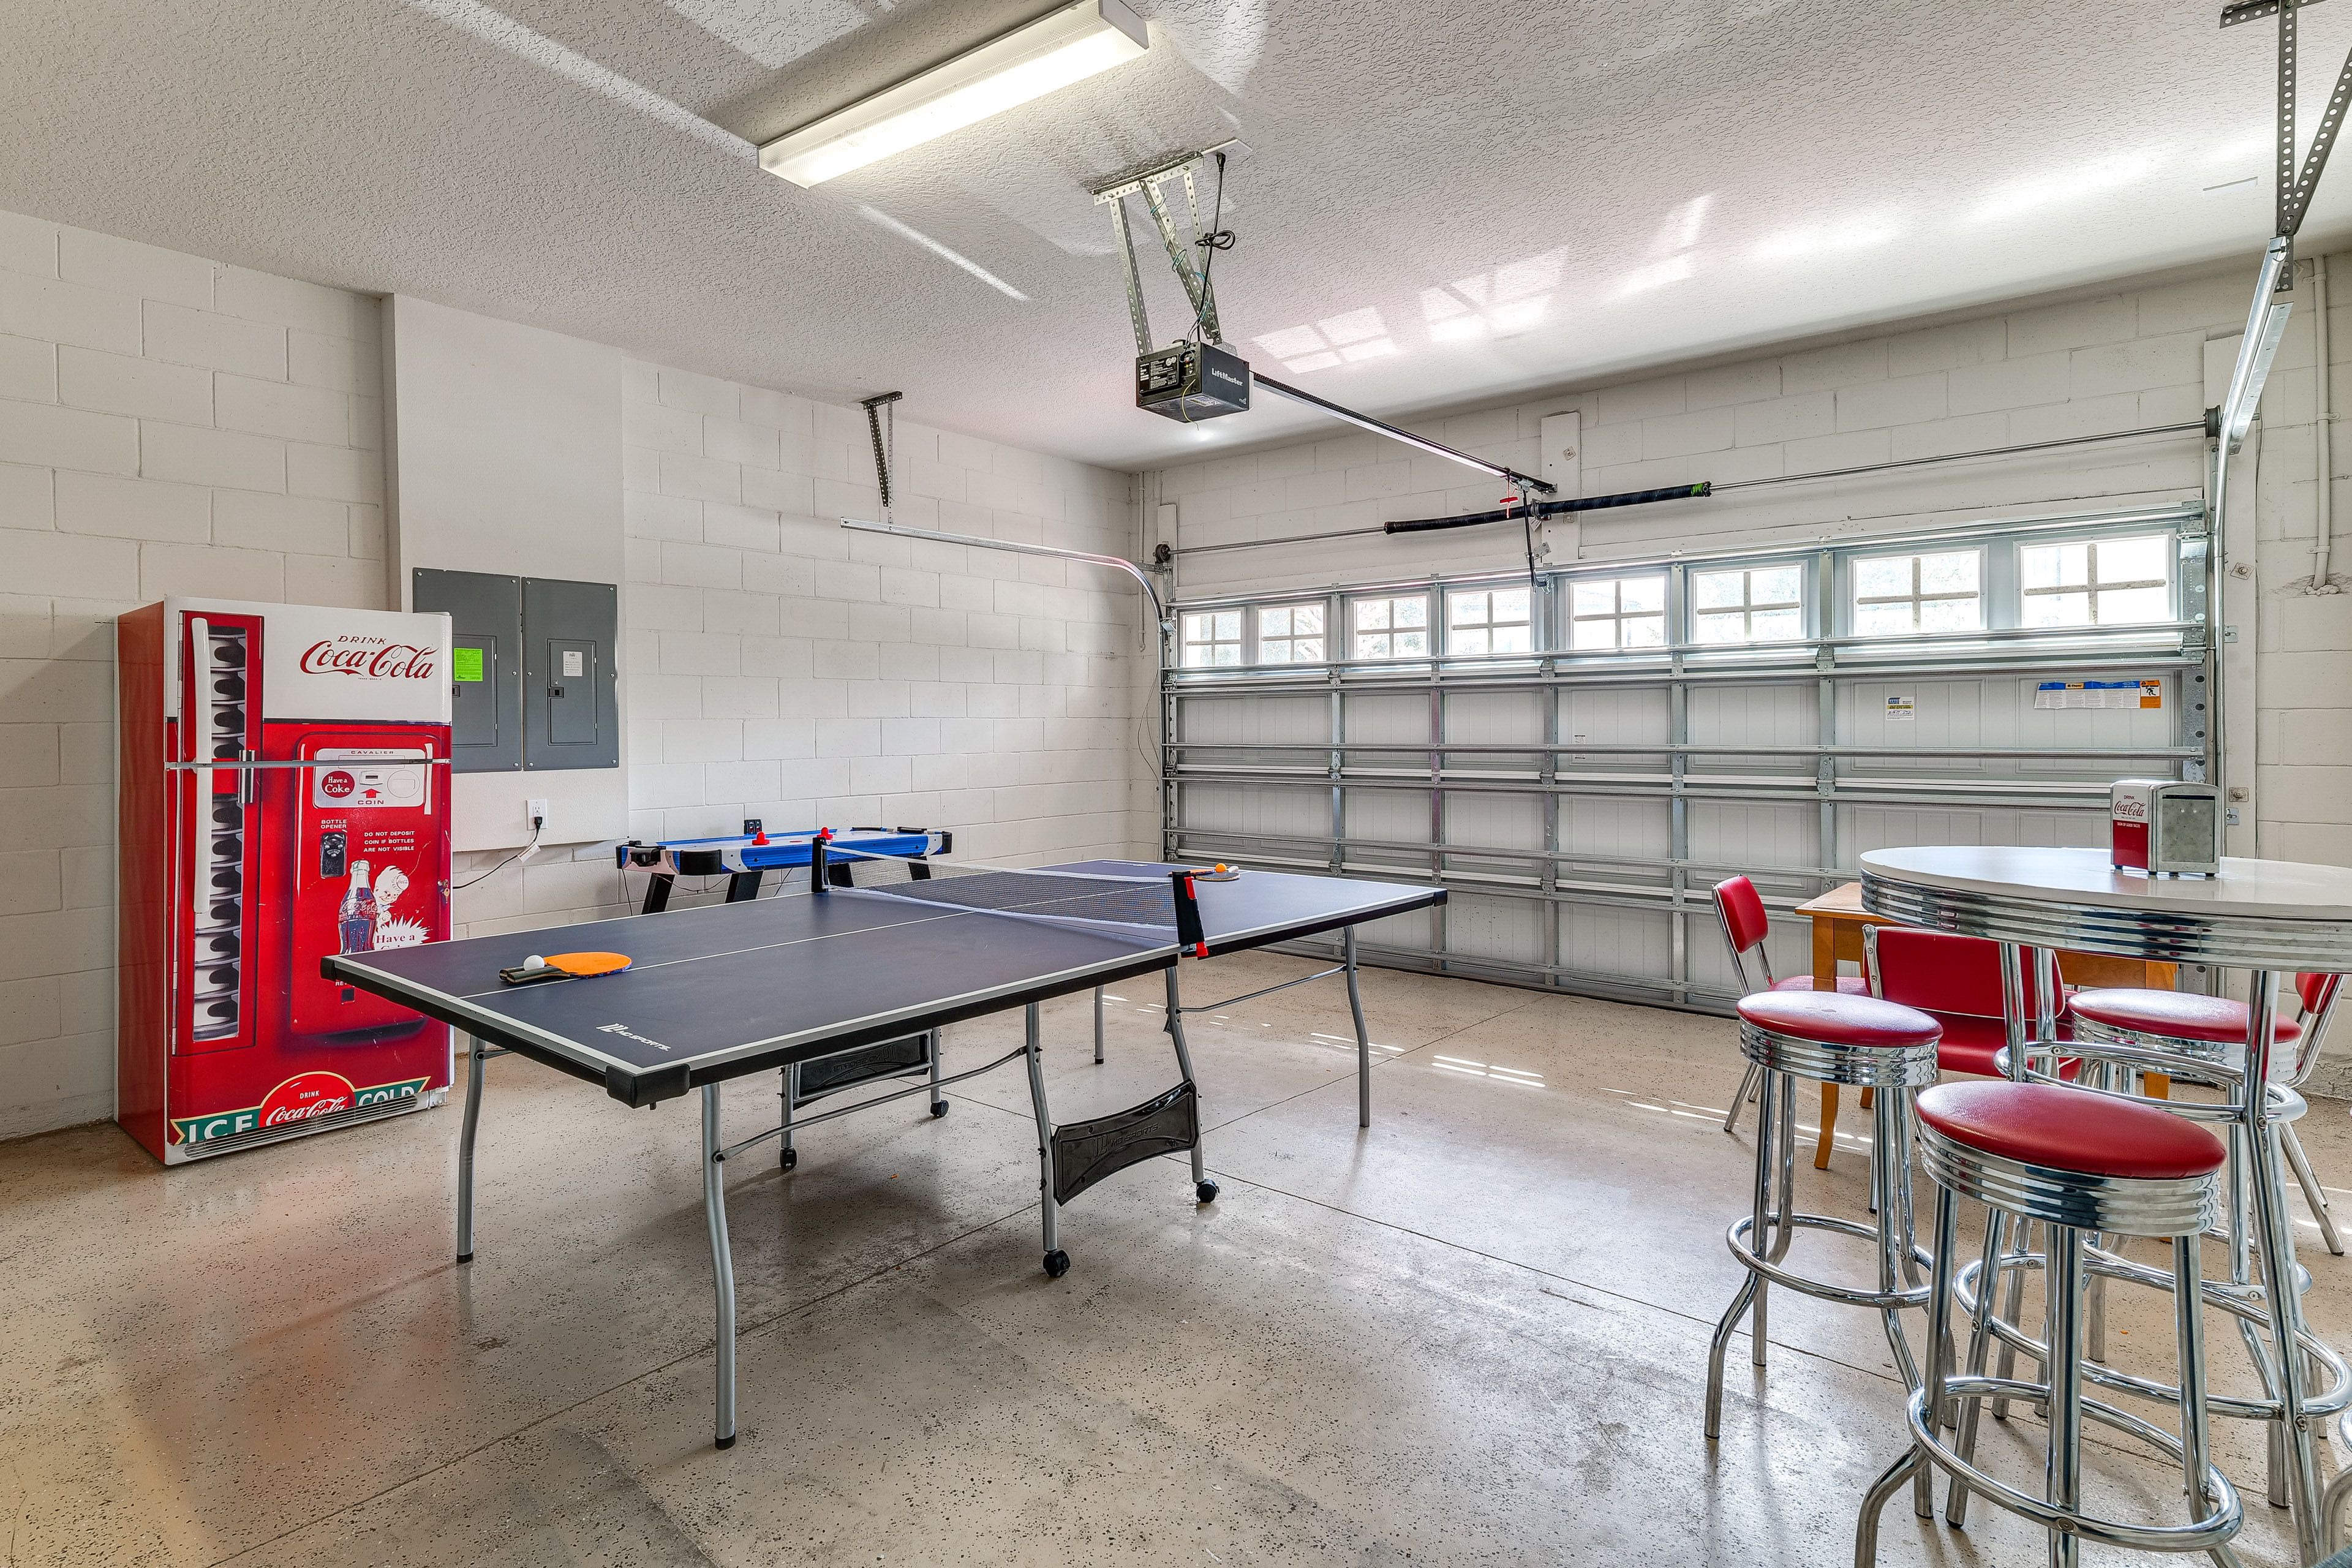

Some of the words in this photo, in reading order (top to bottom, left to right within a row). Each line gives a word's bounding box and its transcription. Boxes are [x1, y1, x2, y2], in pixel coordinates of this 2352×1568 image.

[1212, 368, 1243, 386] LiftMaster
[337, 635, 387, 644] DRINK
[300, 640, 440, 679] Coca-Cola
[325, 784, 350, 793] Coke
[2114, 801, 2146, 817] Coca-Cola
[376, 935, 405, 943] Have
[628, 1035, 671, 1051] SPORTS
[300, 1090, 320, 1099] DRINK
[266, 1096, 349, 1126] Coca-Cola
[189, 1114, 252, 1143] ICE
[1125, 1123, 1158, 1142] SPORTS
